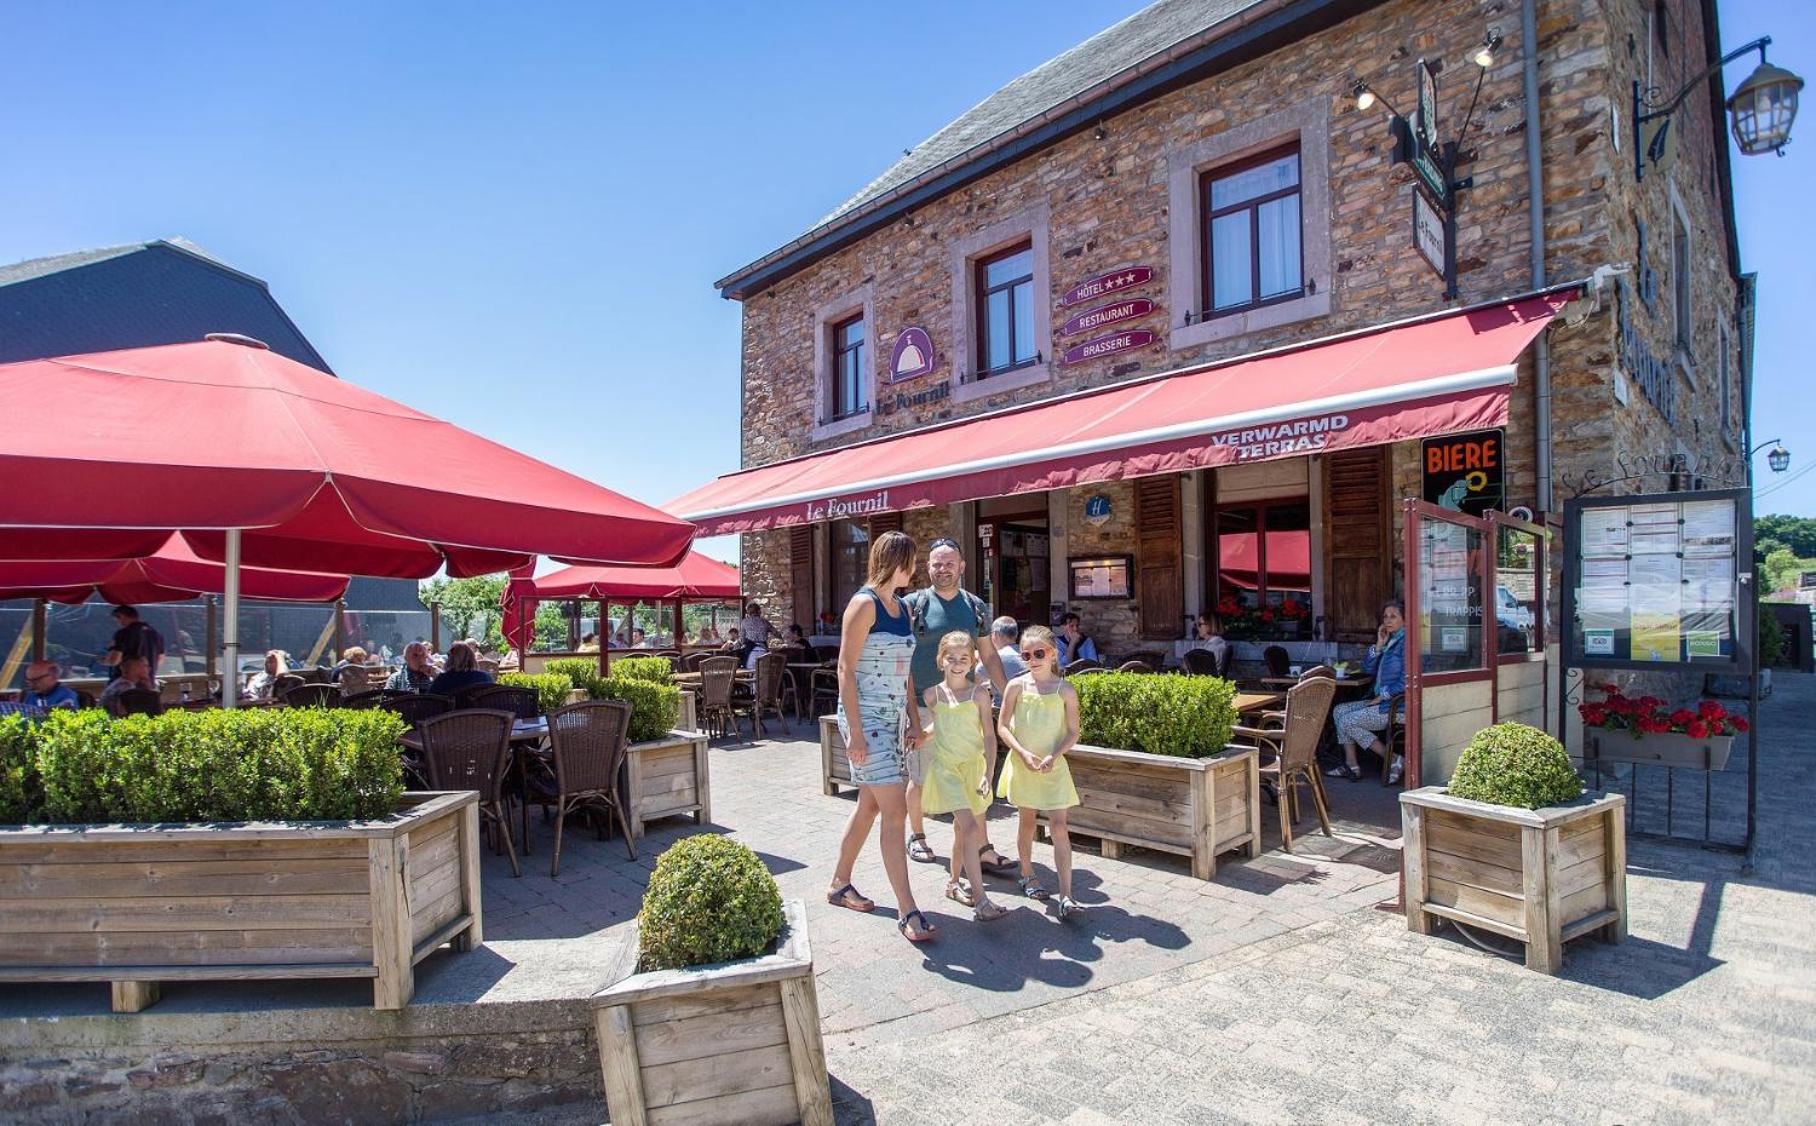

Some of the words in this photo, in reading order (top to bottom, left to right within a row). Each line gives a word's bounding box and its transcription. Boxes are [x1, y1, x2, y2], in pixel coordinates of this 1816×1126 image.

[1079, 303, 1134, 329] RESTAURANT
[1083, 335, 1132, 356] BRASSERIE
[1211, 414, 1349, 447] VERWARMD
[1237, 433, 1327, 459] TERRAS
[1427, 439, 1497, 474] BIERE
[806, 502, 824, 520] le
[827, 489, 889, 518] Fournil
